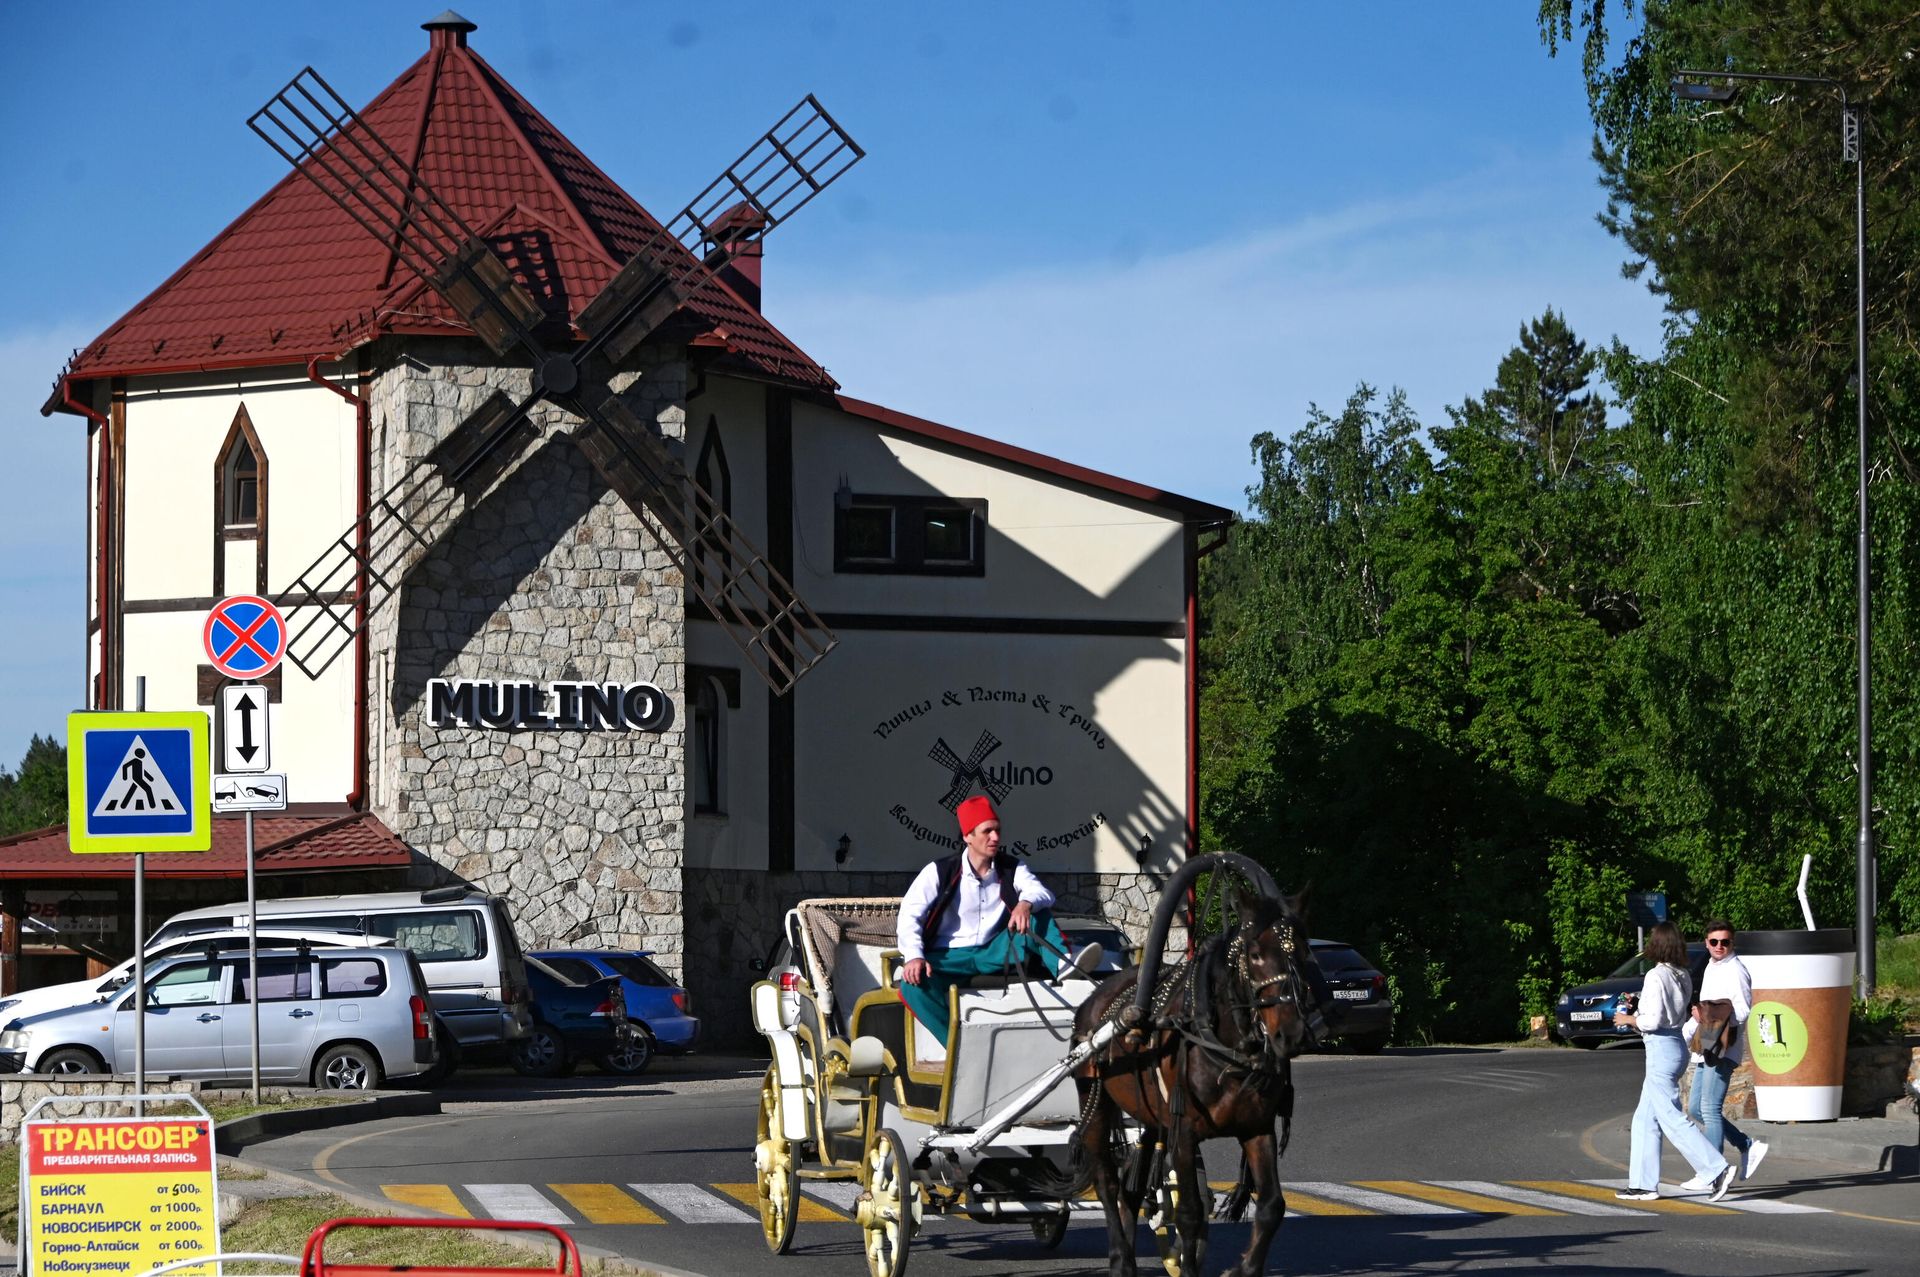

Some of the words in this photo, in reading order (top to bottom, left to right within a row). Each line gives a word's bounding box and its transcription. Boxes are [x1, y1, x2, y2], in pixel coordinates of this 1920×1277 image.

[427, 678, 667, 731] MULINO
[873, 700, 932, 740] Пицца
[941, 690, 962, 708] &
[967, 686, 1026, 702] Паста
[1032, 694, 1051, 714] &
[1058, 704, 1105, 750] Гриль
[951, 761, 1053, 789] Mulino
[1012, 840, 1032, 857] &
[1036, 811, 1107, 852] Кофейня
[38, 1126, 199, 1151] ТРАНСФЕР
[43, 1154, 150, 1166] ПРЕДВАРИТЕЛЬНАЯ
[153, 1153, 197, 1163] ЗАПИСЬ
[40, 1183, 86, 1196] БИЙСК
[41, 1203, 104, 1215] БАРНАУЛ
[150, 1205, 161, 1213] от
[166, 1203, 203, 1213] 1000р.
[42, 1221, 142, 1234] НОВОСИБИРСК
[150, 1224, 161, 1232] от
[166, 1221, 204, 1232] 2000р.
[43, 1240, 139, 1255] Горно-Алтайск
[175, 1240, 205, 1251] 600р.
[43, 1260, 130, 1273] Новокузнецк
